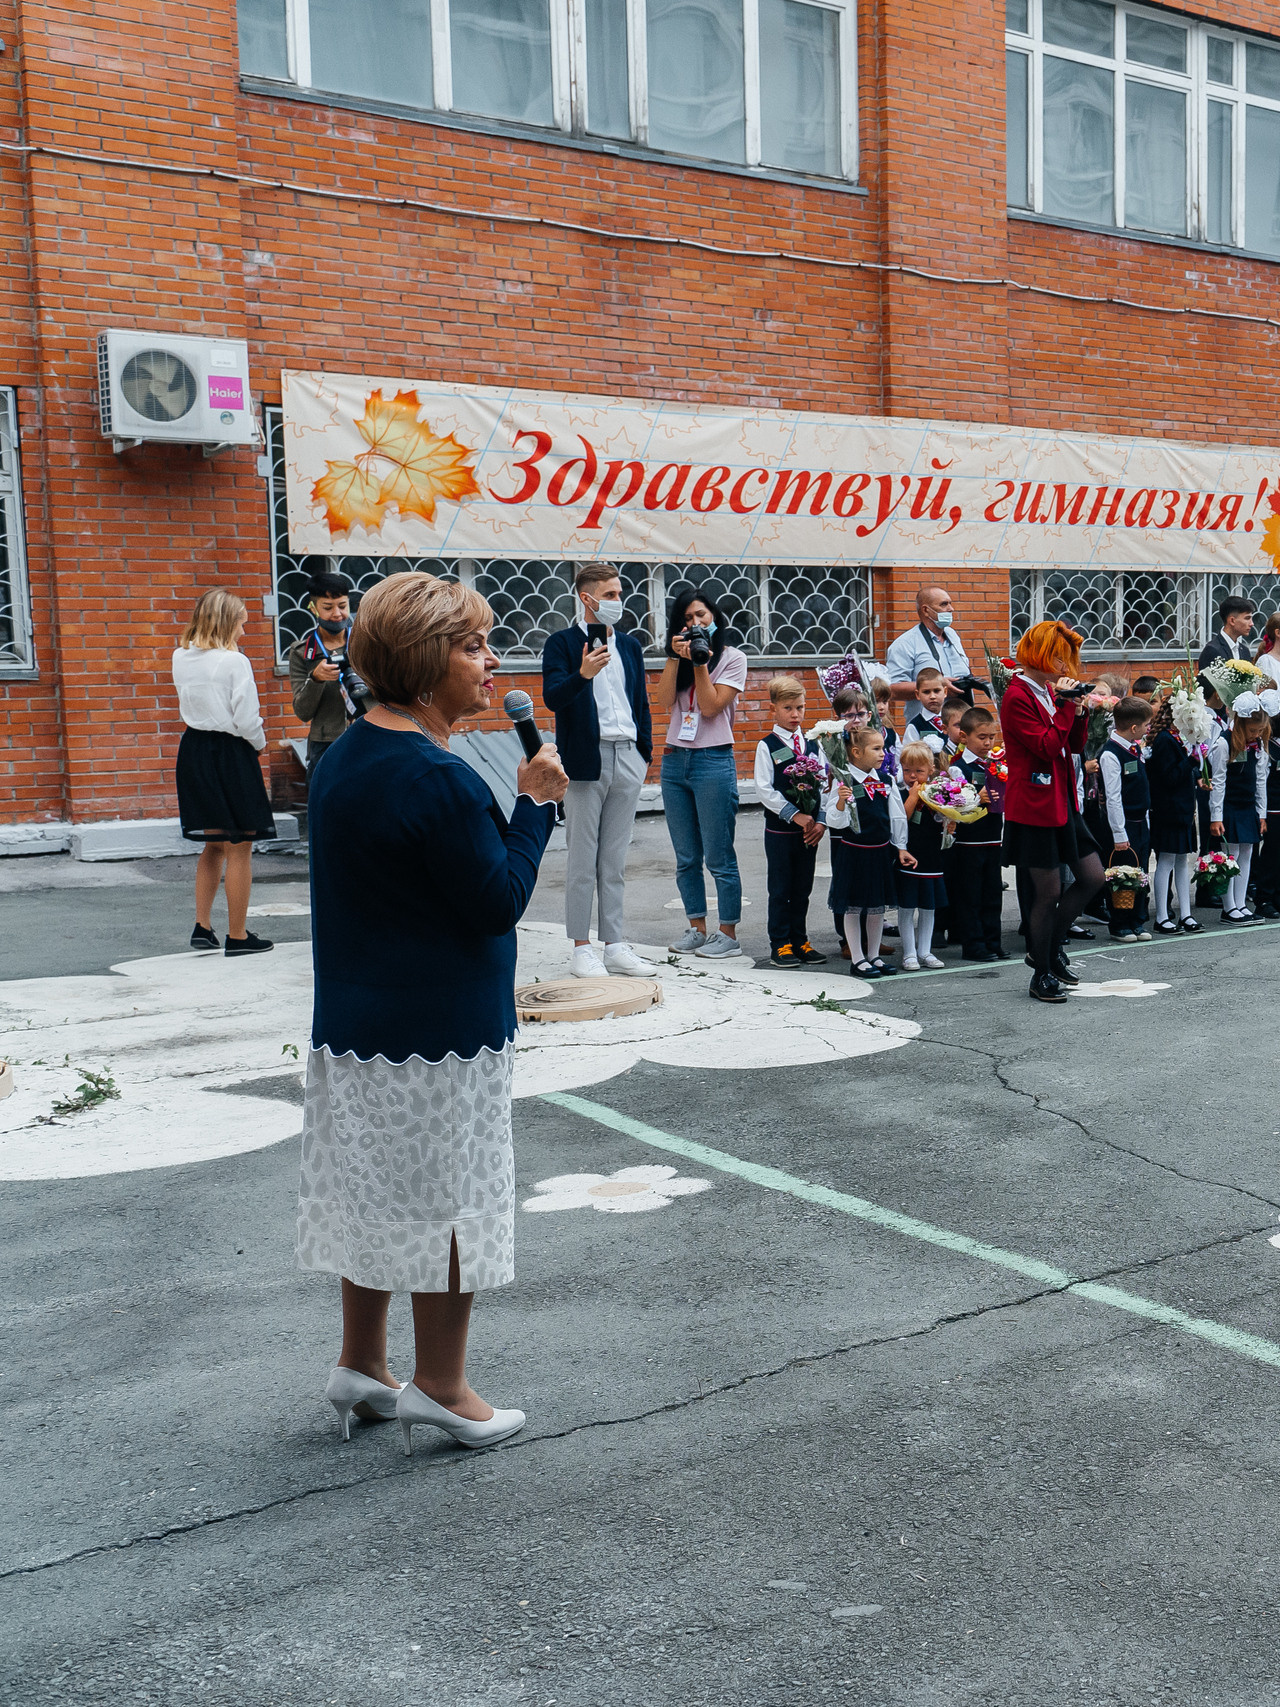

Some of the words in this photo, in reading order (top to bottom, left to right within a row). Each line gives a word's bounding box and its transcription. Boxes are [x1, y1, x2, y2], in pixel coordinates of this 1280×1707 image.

[209, 387, 242, 398] Haier
[488, 429, 963, 538] Здравствуй,
[984, 476, 1269, 533] гимназия!
